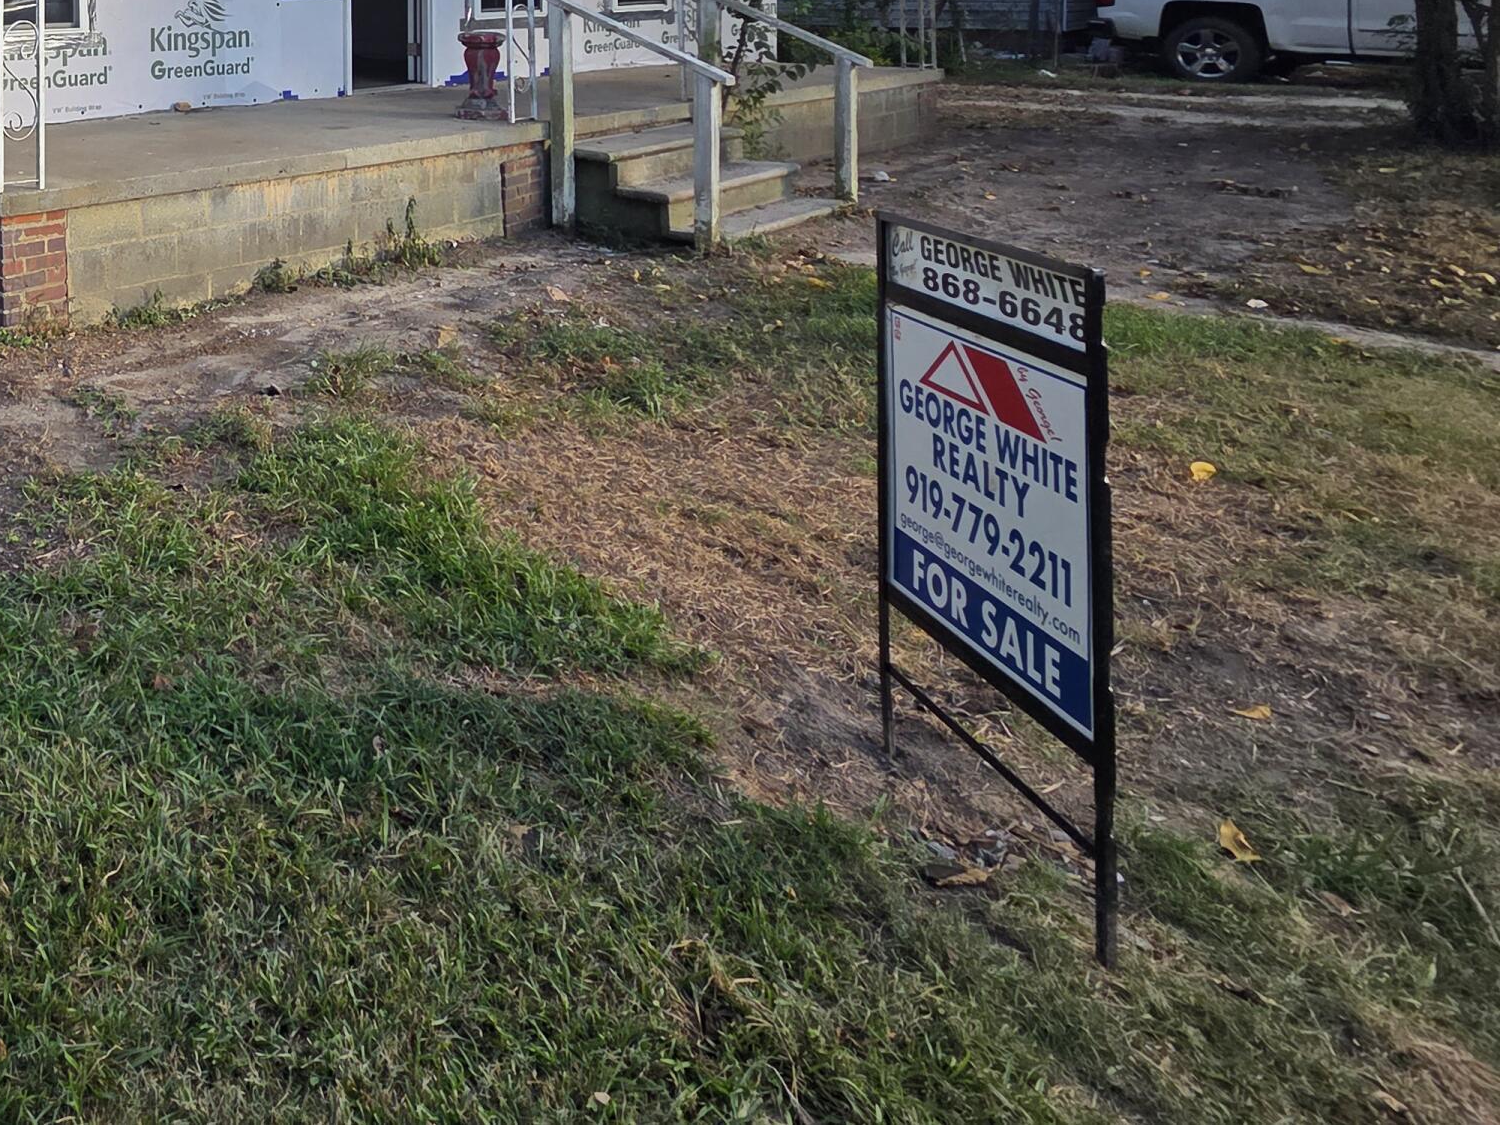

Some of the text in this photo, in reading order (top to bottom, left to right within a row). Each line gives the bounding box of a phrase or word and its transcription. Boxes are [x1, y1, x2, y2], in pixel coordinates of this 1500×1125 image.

[150, 25, 250, 58] Kingspan
[151, 57, 250, 80] GreenGuard
[891, 231, 914, 257] Call
[920, 236, 1003, 283] GEORGE
[1007, 259, 1085, 308] WHITE
[922, 266, 1085, 342] 868-6648
[900, 378, 1078, 504] GEORGE WHITE
[932, 432, 1030, 518] REALTY
[906, 465, 1072, 608] 919-779-2211
[900, 513, 1081, 645] george@georgewhiterealty.com
[912, 548, 1061, 700] FOR SALE
